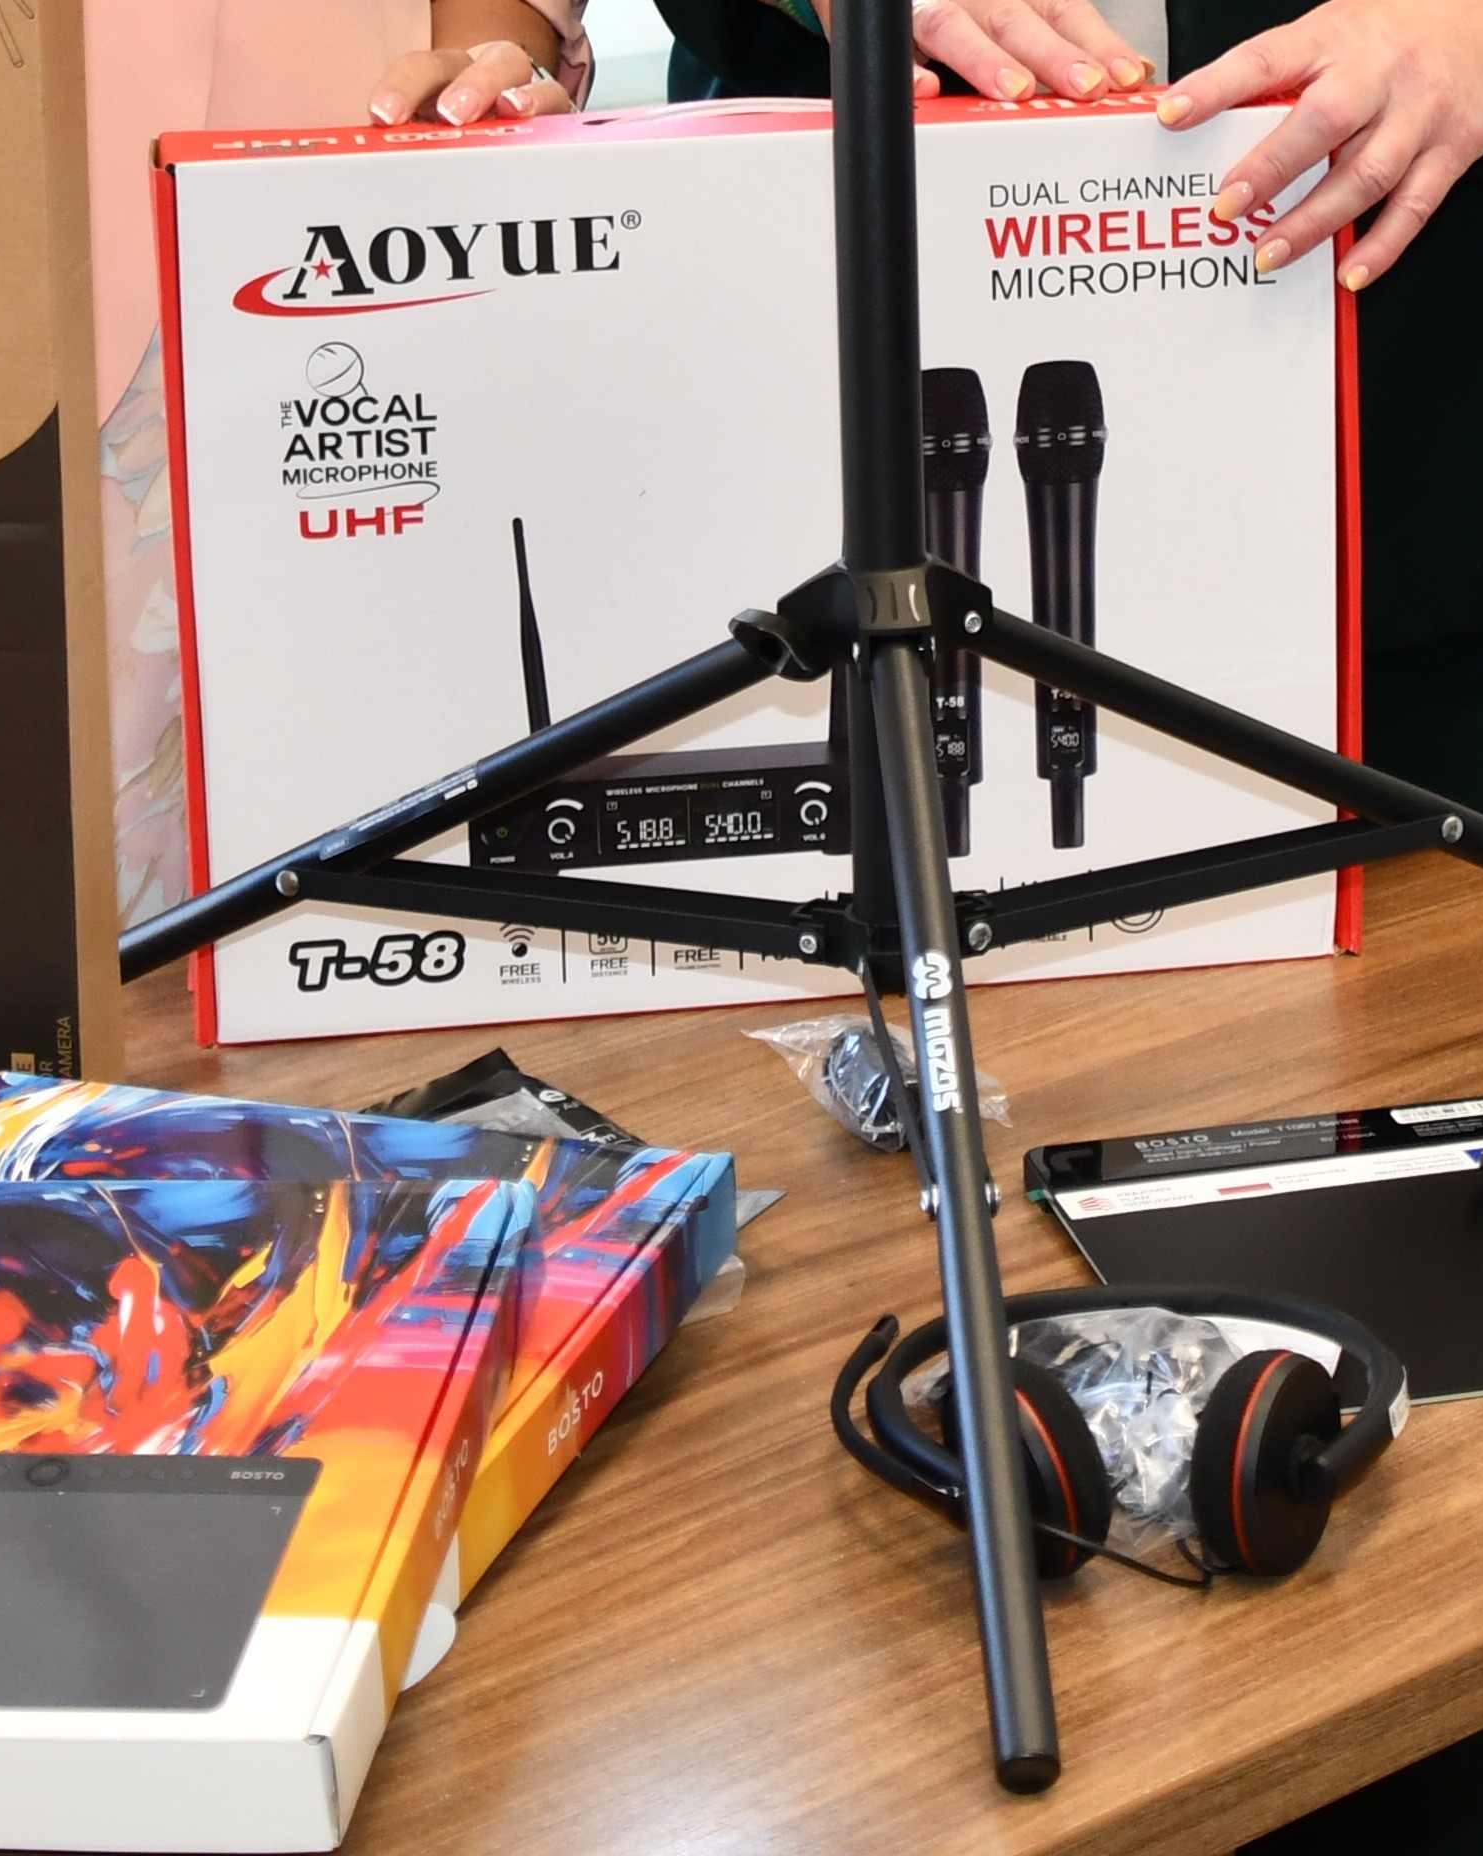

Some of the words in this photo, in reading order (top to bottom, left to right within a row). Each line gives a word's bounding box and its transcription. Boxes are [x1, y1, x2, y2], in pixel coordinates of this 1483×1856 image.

[989, 180, 1069, 209] DUAL
[1080, 173, 1220, 203] CHANNEL
[985, 201, 1276, 260] WIRELESS
[281, 401, 293, 429] THE
[294, 393, 437, 428] VOCAL
[283, 426, 436, 463] ARTIST
[282, 461, 438, 486] MICROPHONE
[299, 503, 424, 540] UHF
[605, 786, 643, 796] WIRELESS
[645, 783, 699, 794] MICROPHONE
[722, 778, 764, 789] CHANNELS
[289, 929, 466, 993] T-58
[499, 963, 541, 977] FREE
[590, 957, 628, 971] FREE
[674, 948, 720, 964] FREE
[501, 976, 541, 985] WIRELESS
[57, 1016, 72, 1079] AMERA
[1134, 1134, 1209, 1150] BOSTO
[547, 1370, 605, 1457] BOSTO
[229, 1469, 285, 1481] BOSTO
